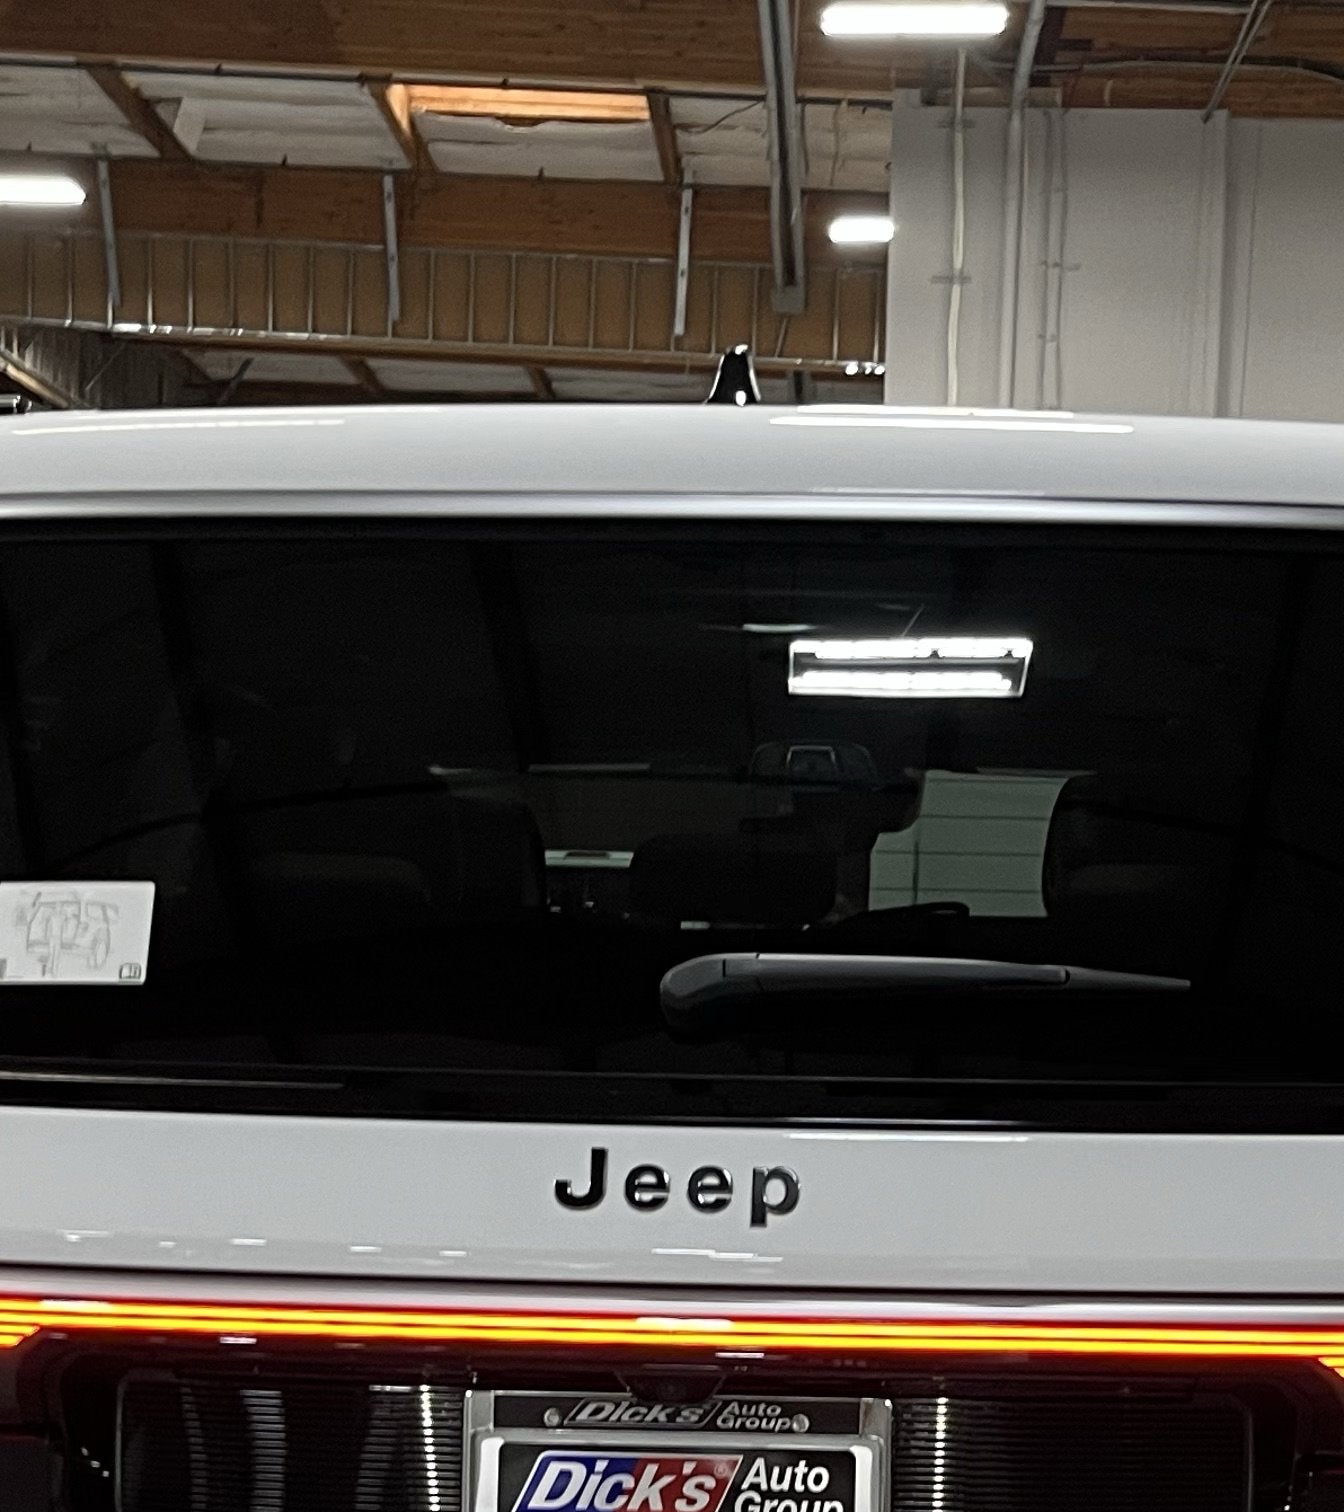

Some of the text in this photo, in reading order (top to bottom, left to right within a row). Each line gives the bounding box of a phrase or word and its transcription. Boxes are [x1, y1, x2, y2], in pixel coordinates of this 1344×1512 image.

[554, 1146, 799, 1228] Jeep
[724, 1401, 782, 1417] Auto
[716, 1414, 792, 1433] Group
[740, 1457, 830, 1493] Auto
